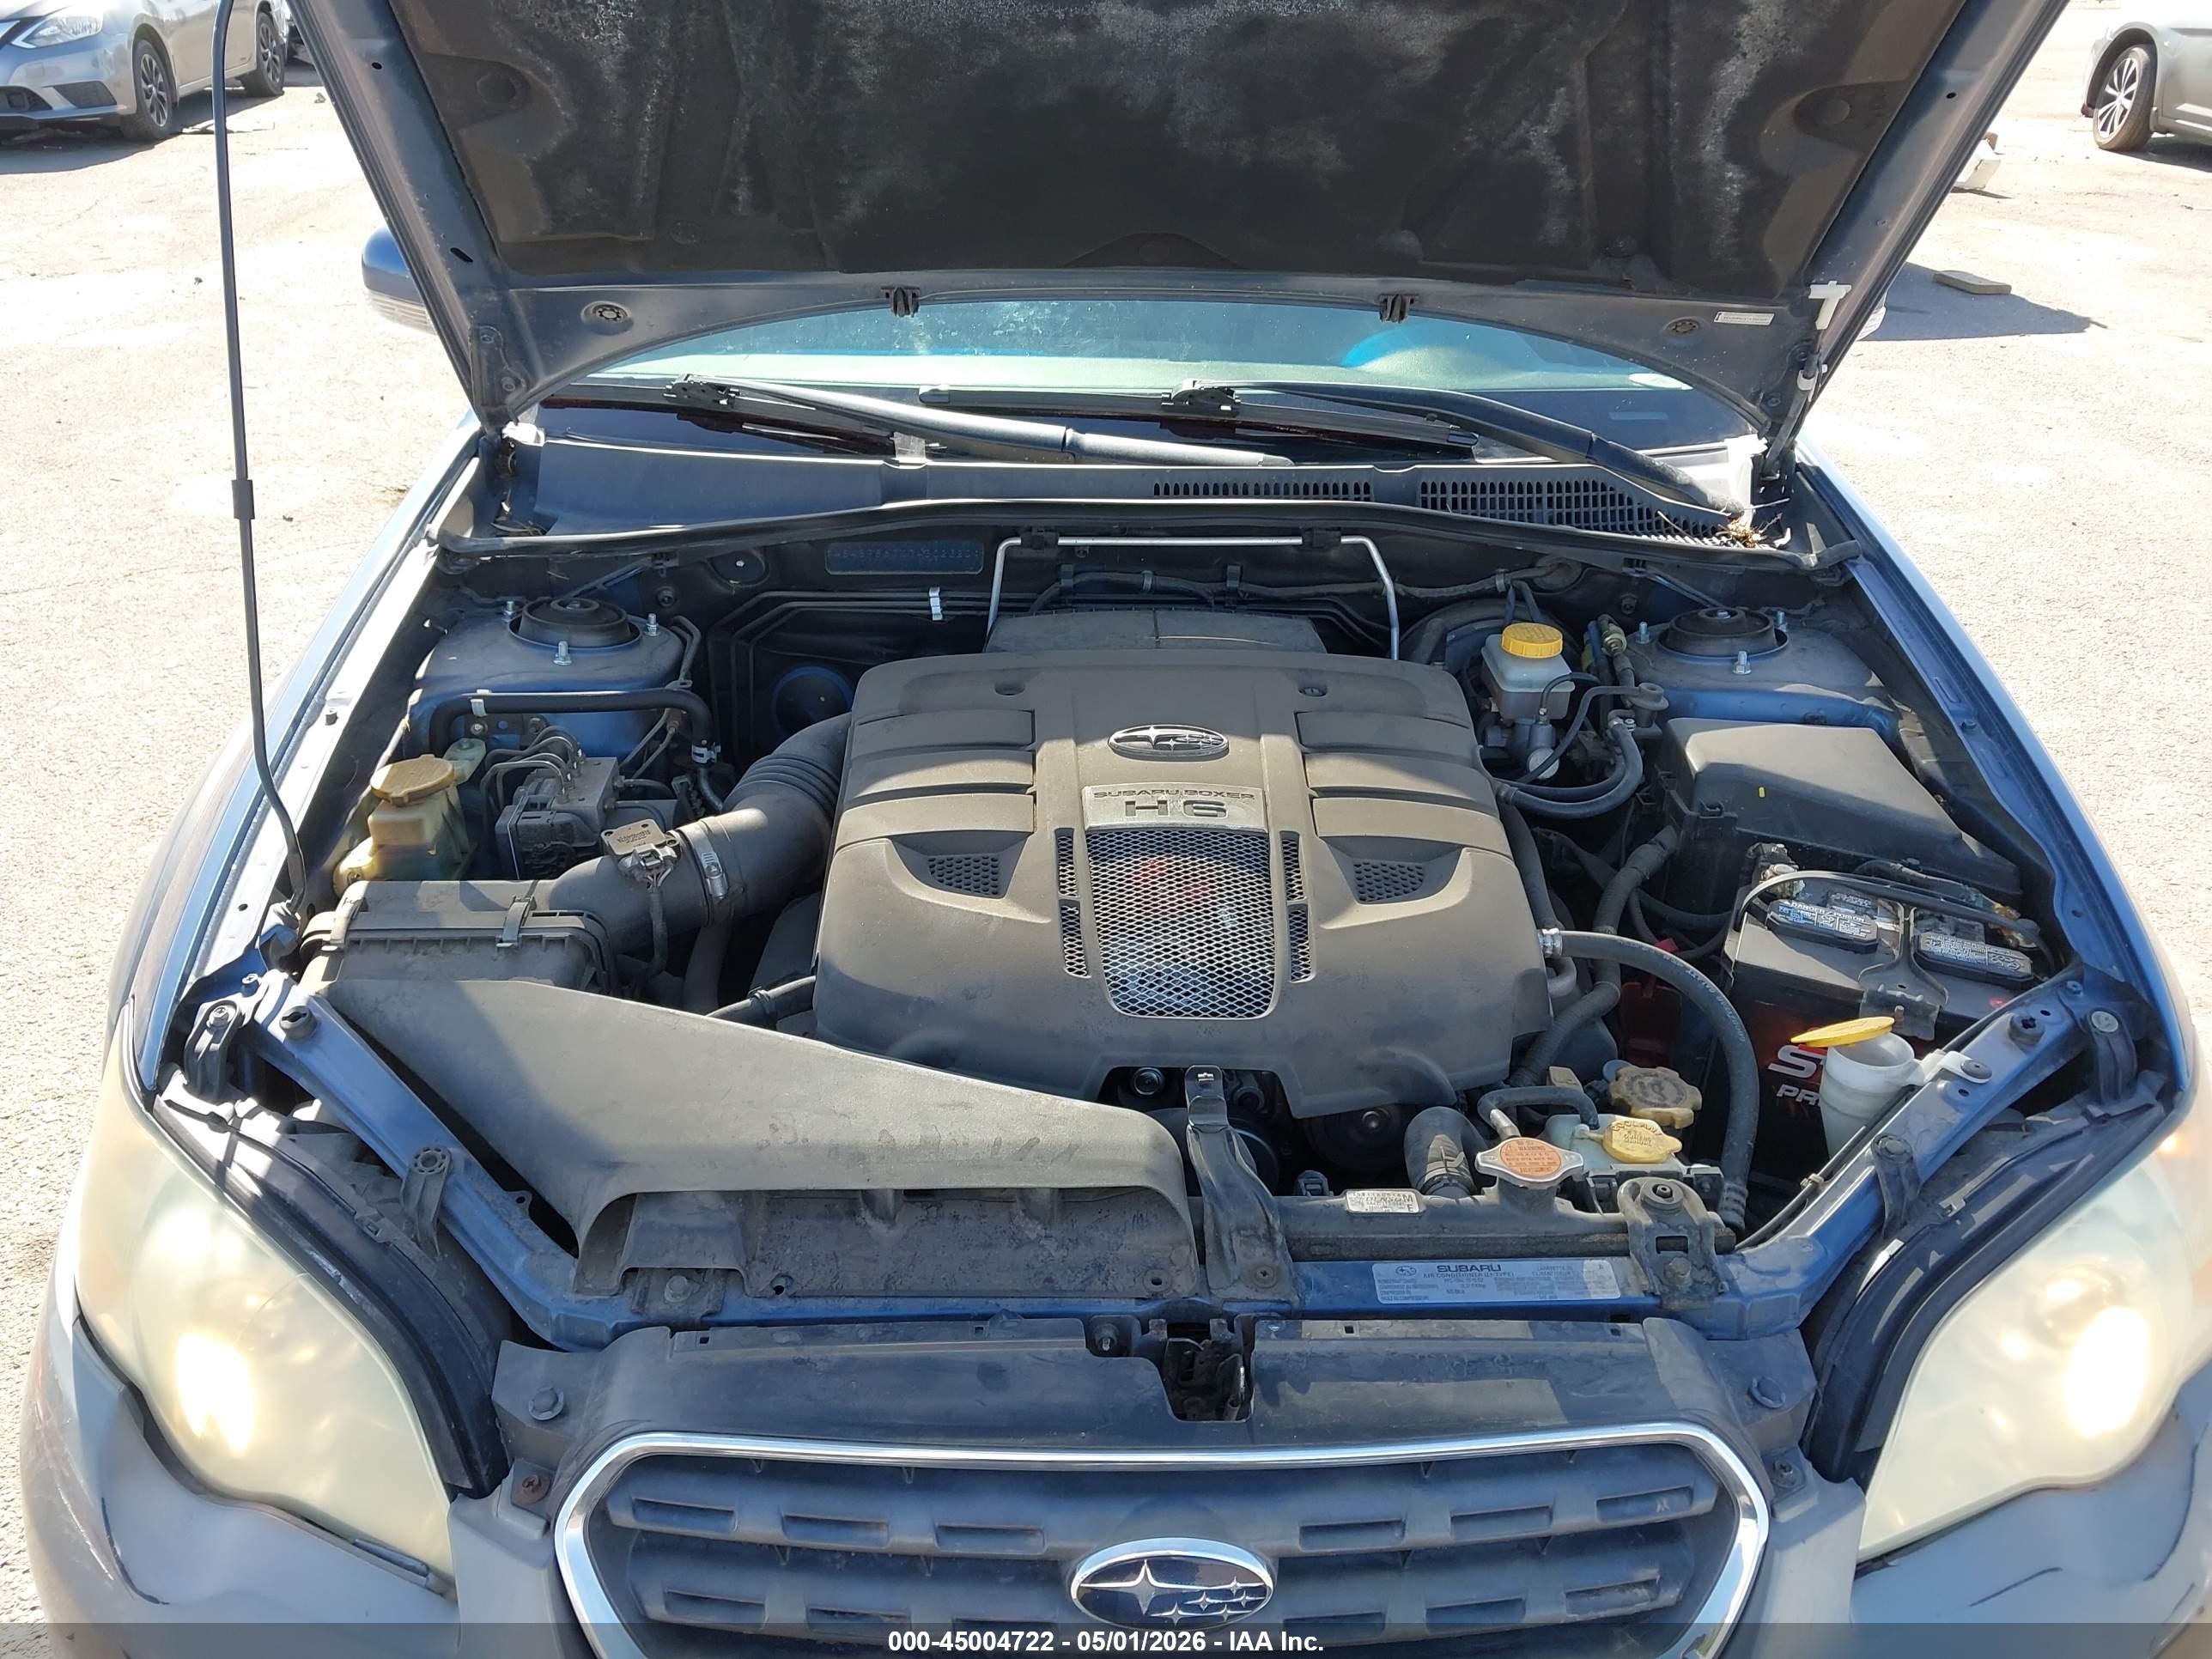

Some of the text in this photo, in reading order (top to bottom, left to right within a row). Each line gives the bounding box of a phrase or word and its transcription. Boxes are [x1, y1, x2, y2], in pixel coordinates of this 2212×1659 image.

[1093, 789, 1255, 799] SUBARU BOXER
[1125, 799, 1228, 817] H6
[1776, 1085, 1820, 1107] PR
